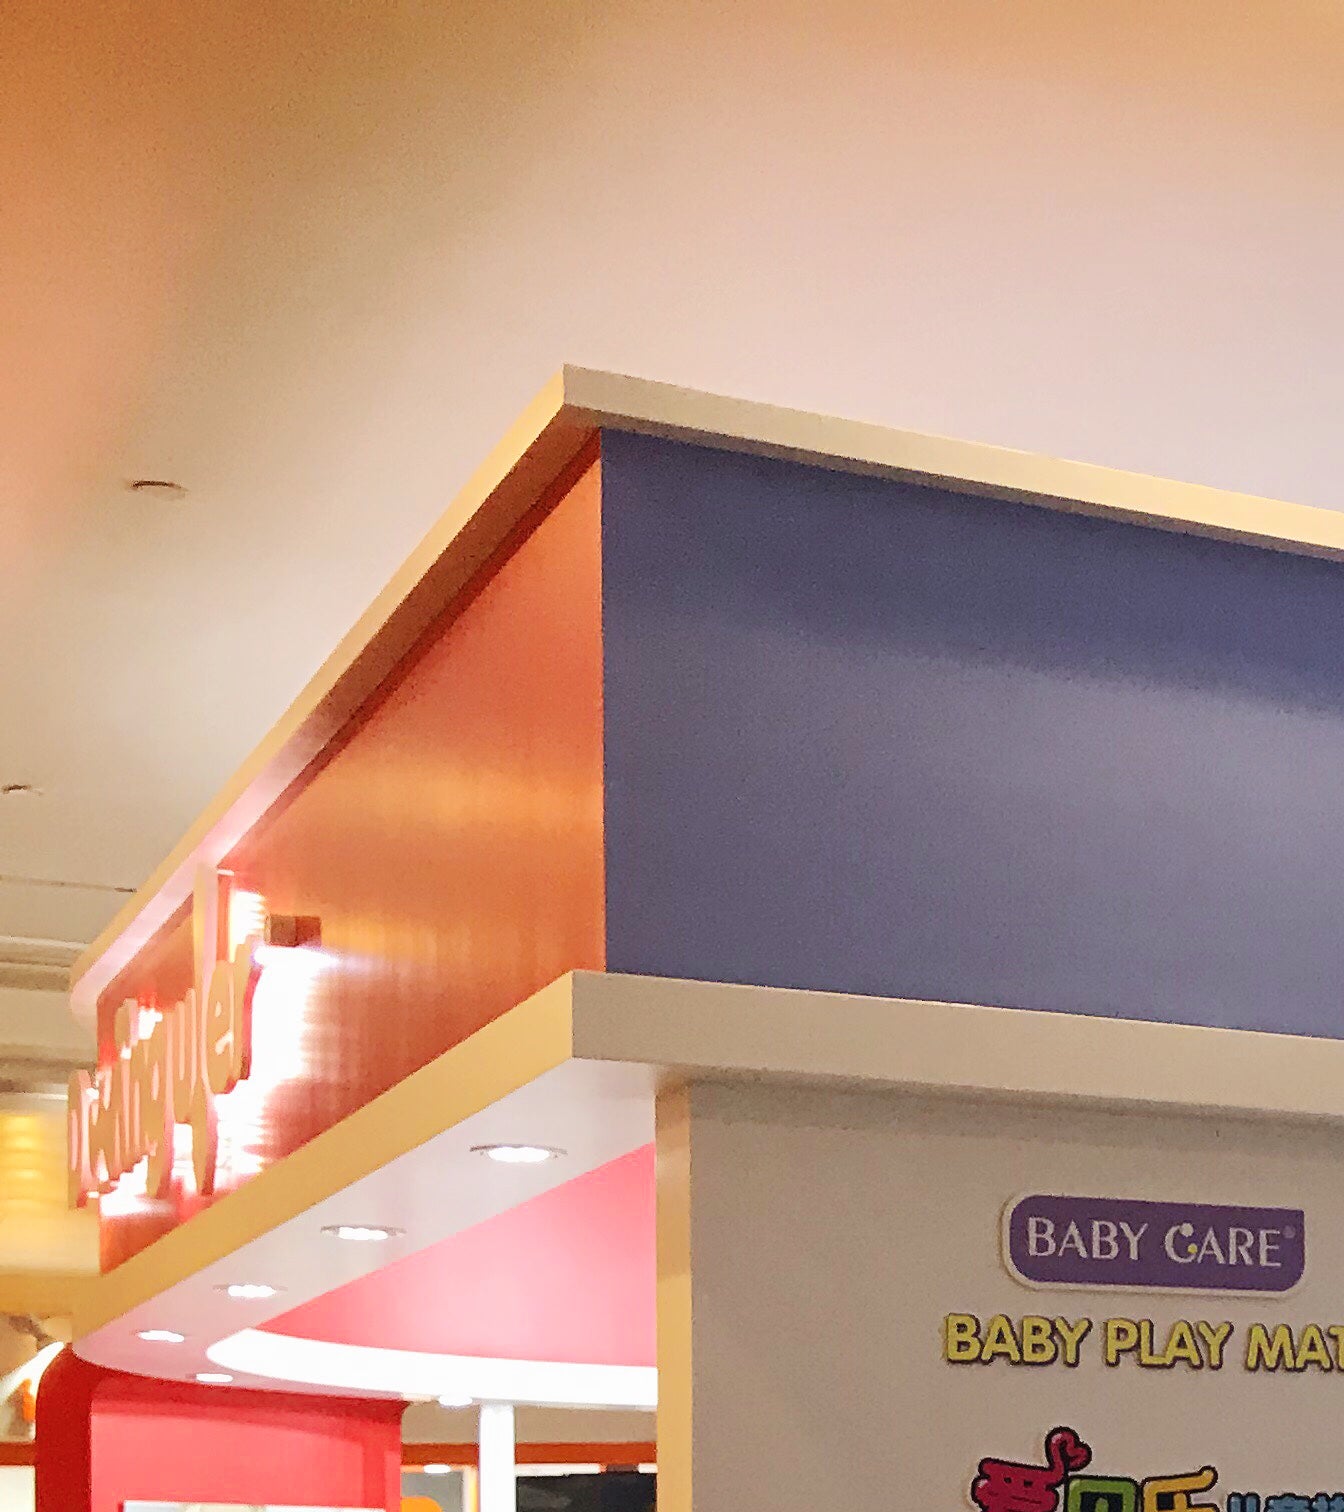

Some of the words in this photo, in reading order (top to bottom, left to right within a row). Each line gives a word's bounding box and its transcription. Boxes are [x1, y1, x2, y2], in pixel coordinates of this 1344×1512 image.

[1027, 1216, 1149, 1261] BABY
[1164, 1221, 1282, 1267] CARE
[945, 1313, 1091, 1367] BABY
[1103, 1318, 1234, 1371] PLAY
